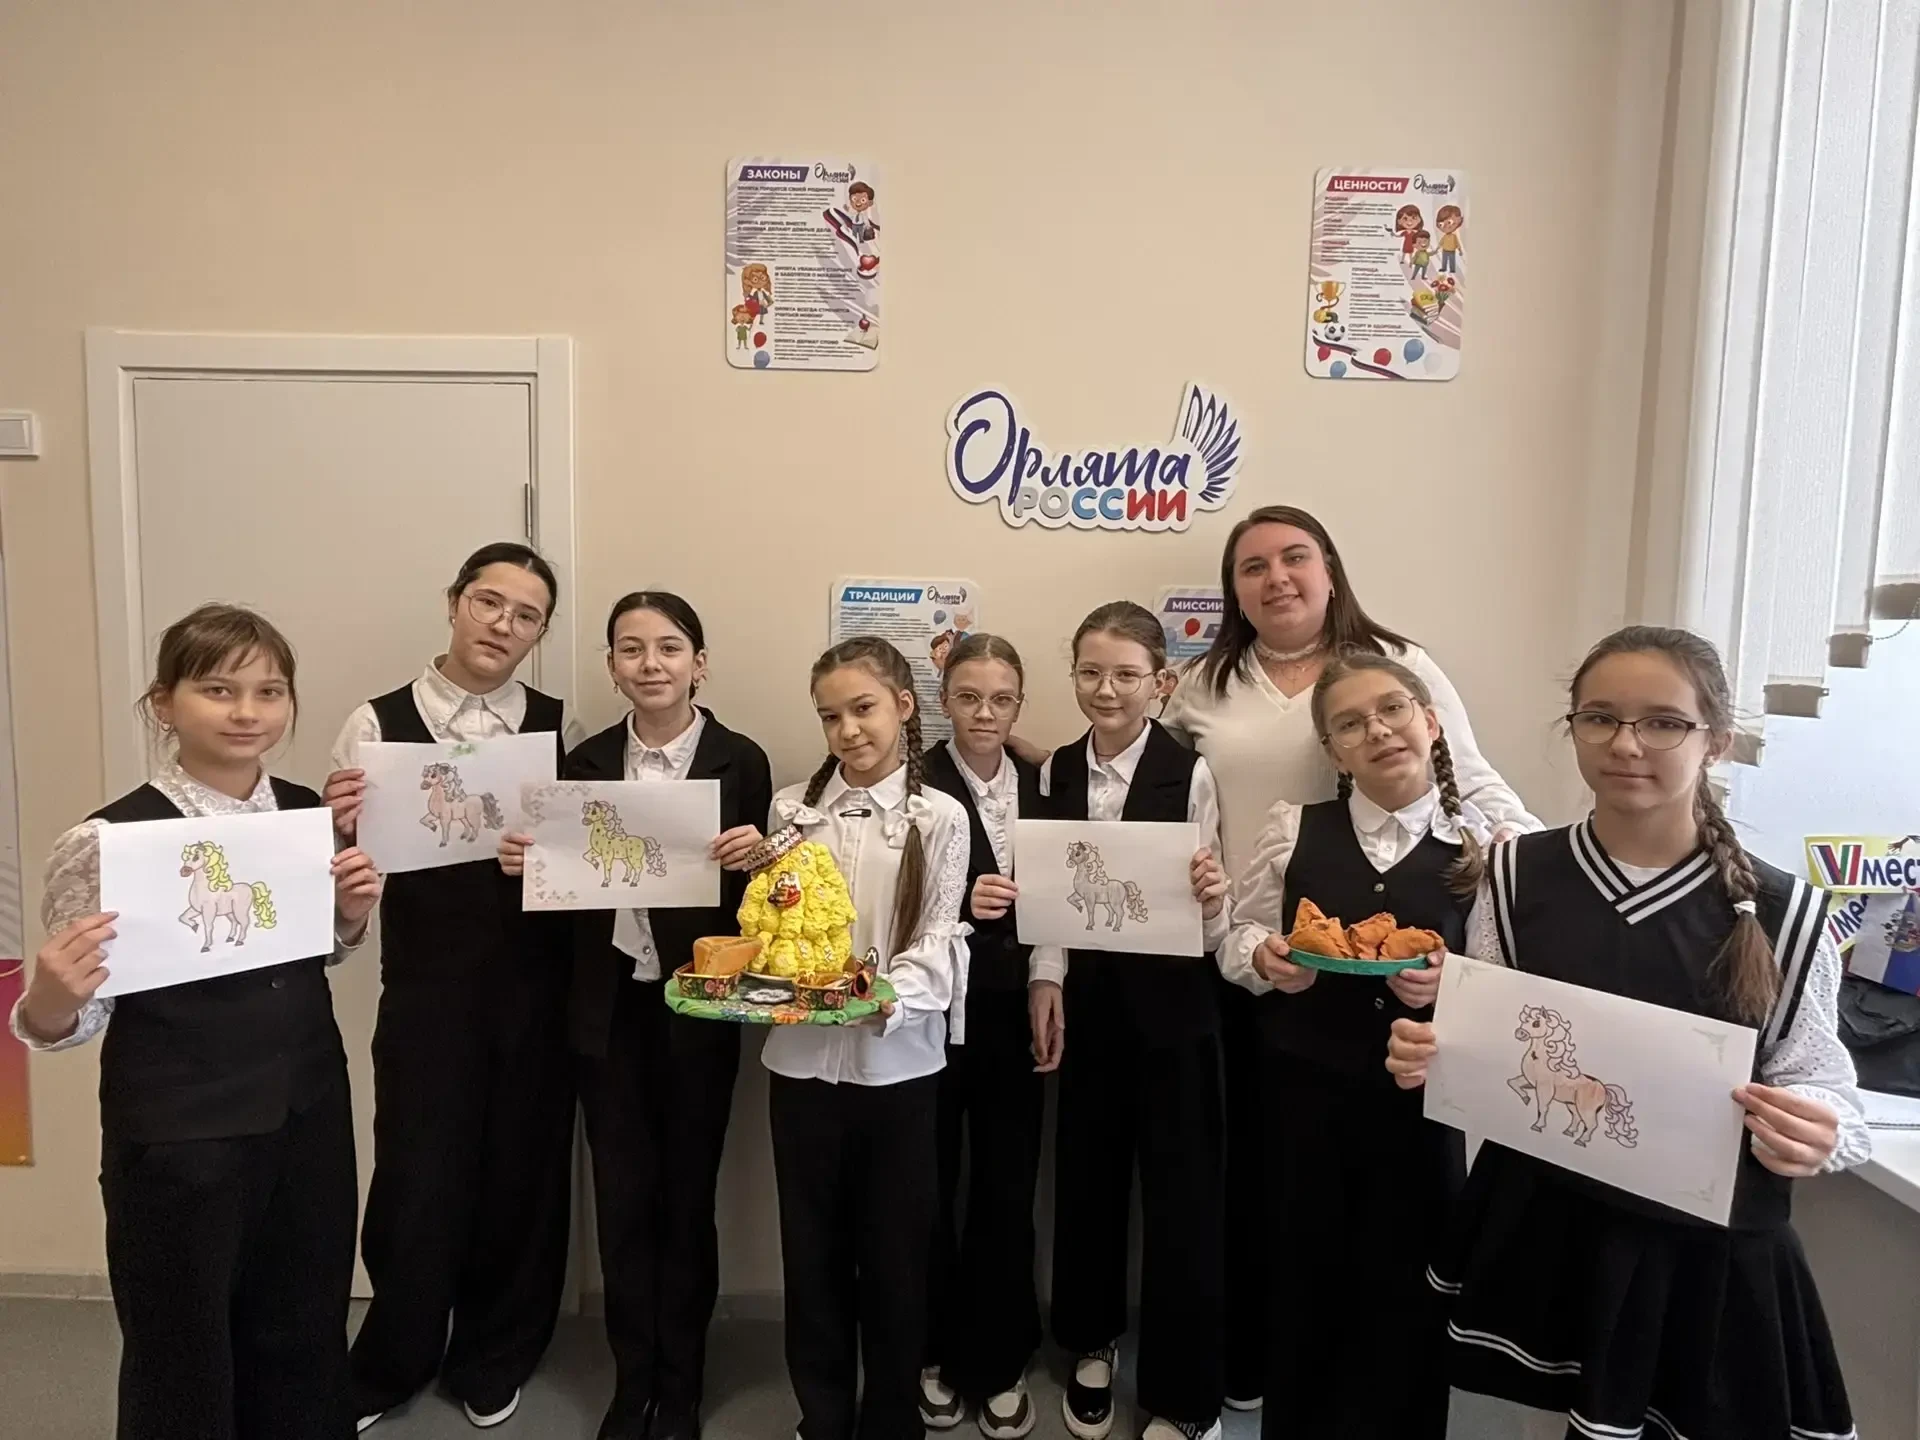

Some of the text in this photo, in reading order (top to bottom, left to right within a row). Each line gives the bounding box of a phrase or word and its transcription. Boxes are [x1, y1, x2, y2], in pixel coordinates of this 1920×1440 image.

[747, 169, 801, 180] ЗАКОНЫ
[1334, 179, 1402, 192] ЦЕННОСТИ
[954, 391, 1191, 506] Орлята
[1013, 486, 1187, 521] РОССИИ
[849, 591, 916, 602] ТРАДИЦИИ
[1172, 601, 1224, 611] МИССИИ
[1810, 844, 1920, 886] Vмес
